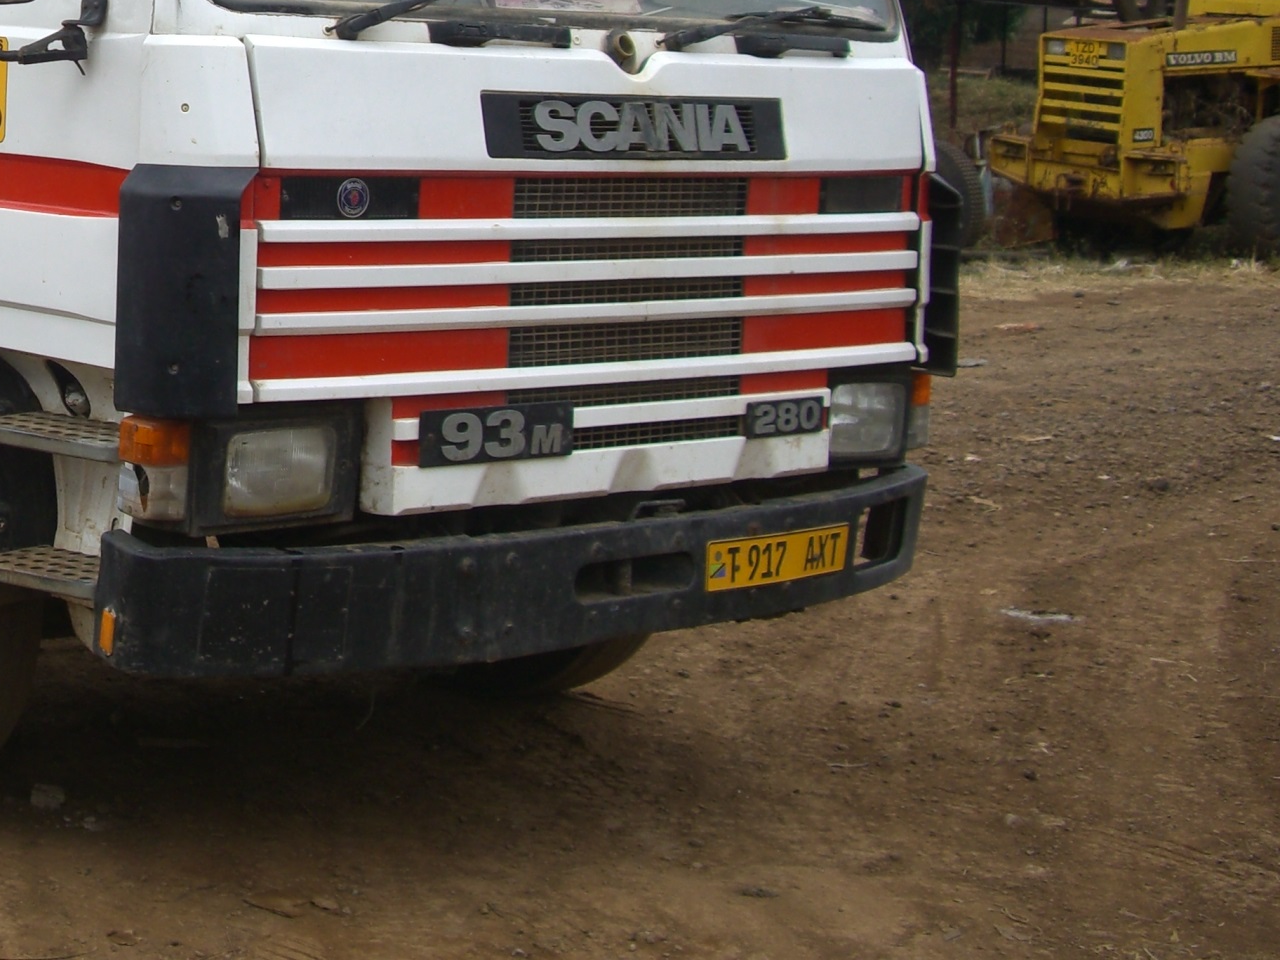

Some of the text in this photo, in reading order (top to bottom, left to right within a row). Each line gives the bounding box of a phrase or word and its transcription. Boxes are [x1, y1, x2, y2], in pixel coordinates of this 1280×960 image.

[1168, 51, 1237, 65] VOLVO BM
[534, 100, 751, 152] SCANIA
[753, 400, 820, 434] 280
[803, 532, 842, 571] AXT
